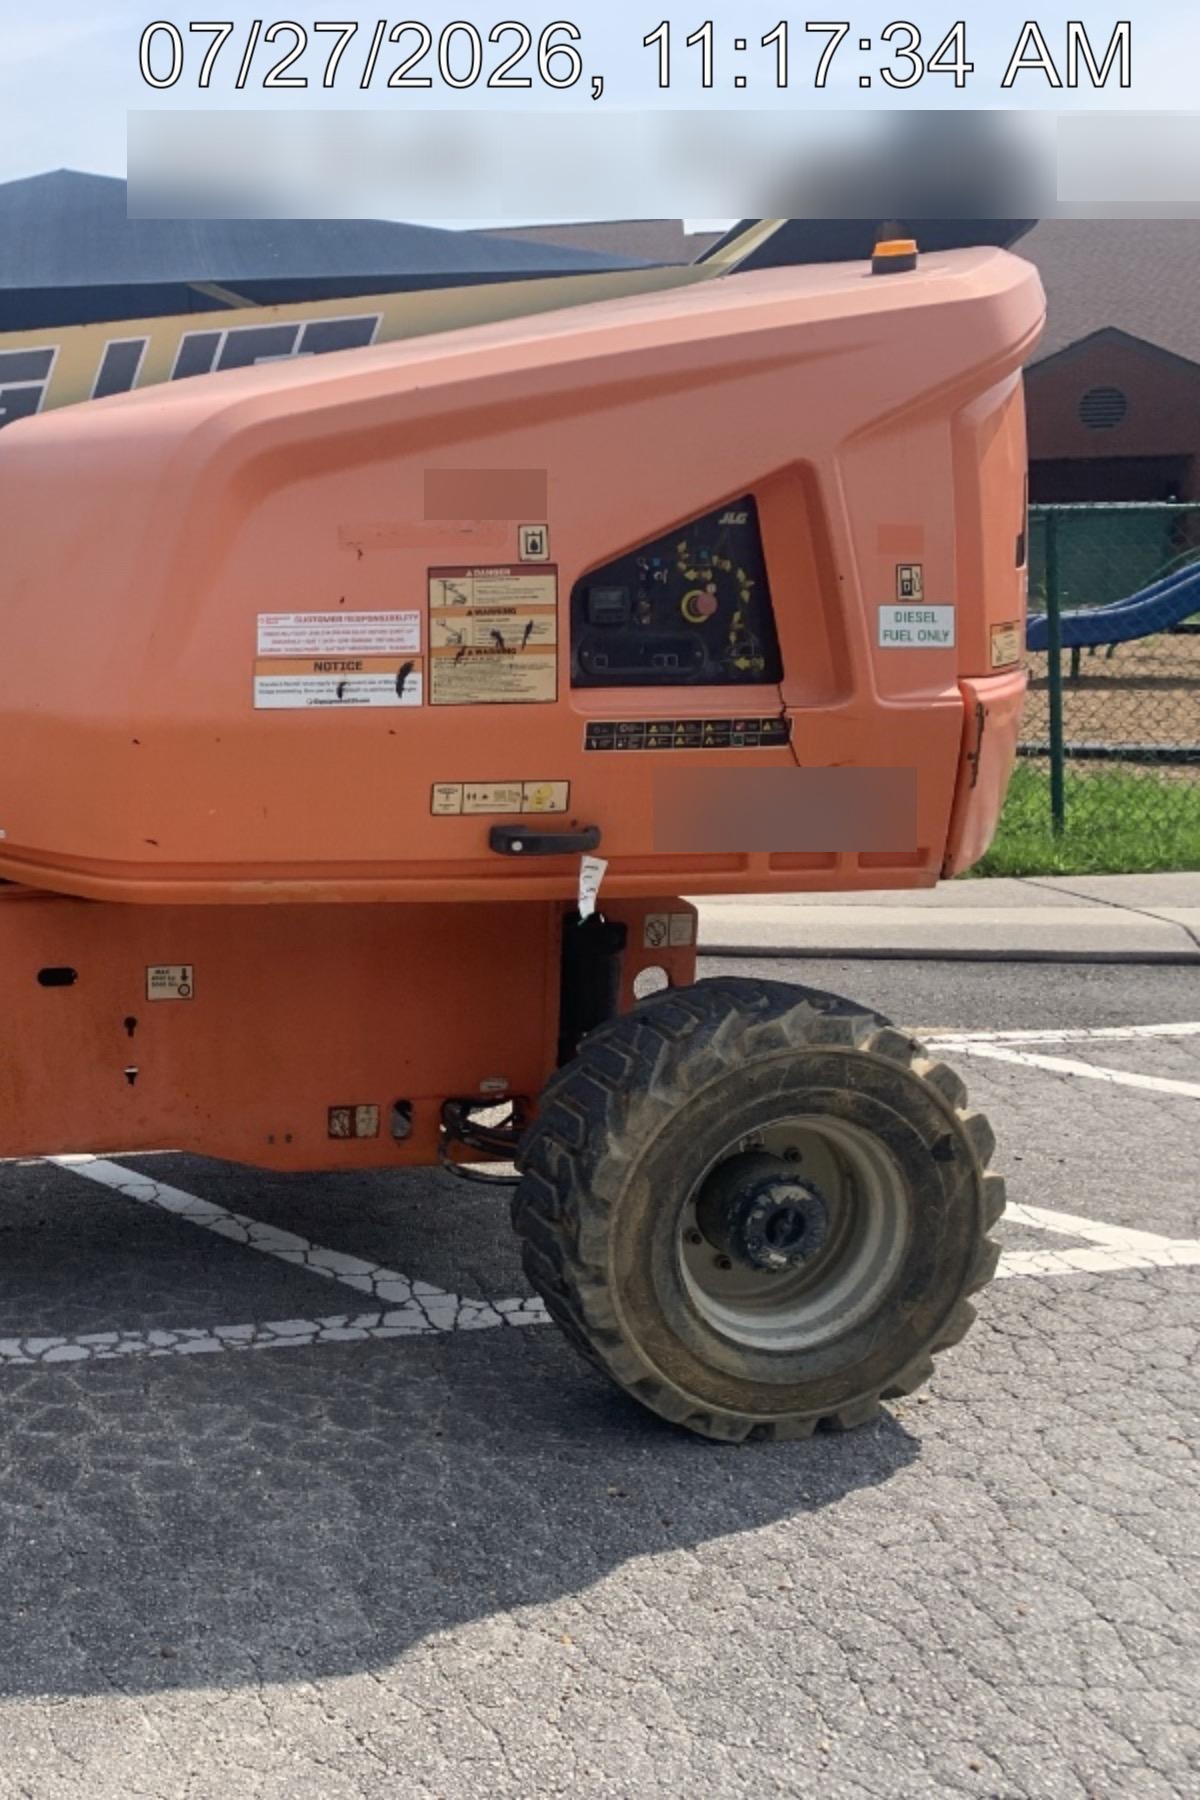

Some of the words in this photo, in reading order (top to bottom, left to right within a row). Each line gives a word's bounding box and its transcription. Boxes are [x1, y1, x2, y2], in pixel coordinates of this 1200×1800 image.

[718, 512, 748, 524] JLG
[894, 611, 937, 624] DIESEL
[883, 629, 912, 642] FUEL
[917, 629, 949, 642] ONLY
[313, 661, 363, 671] NOTICE
